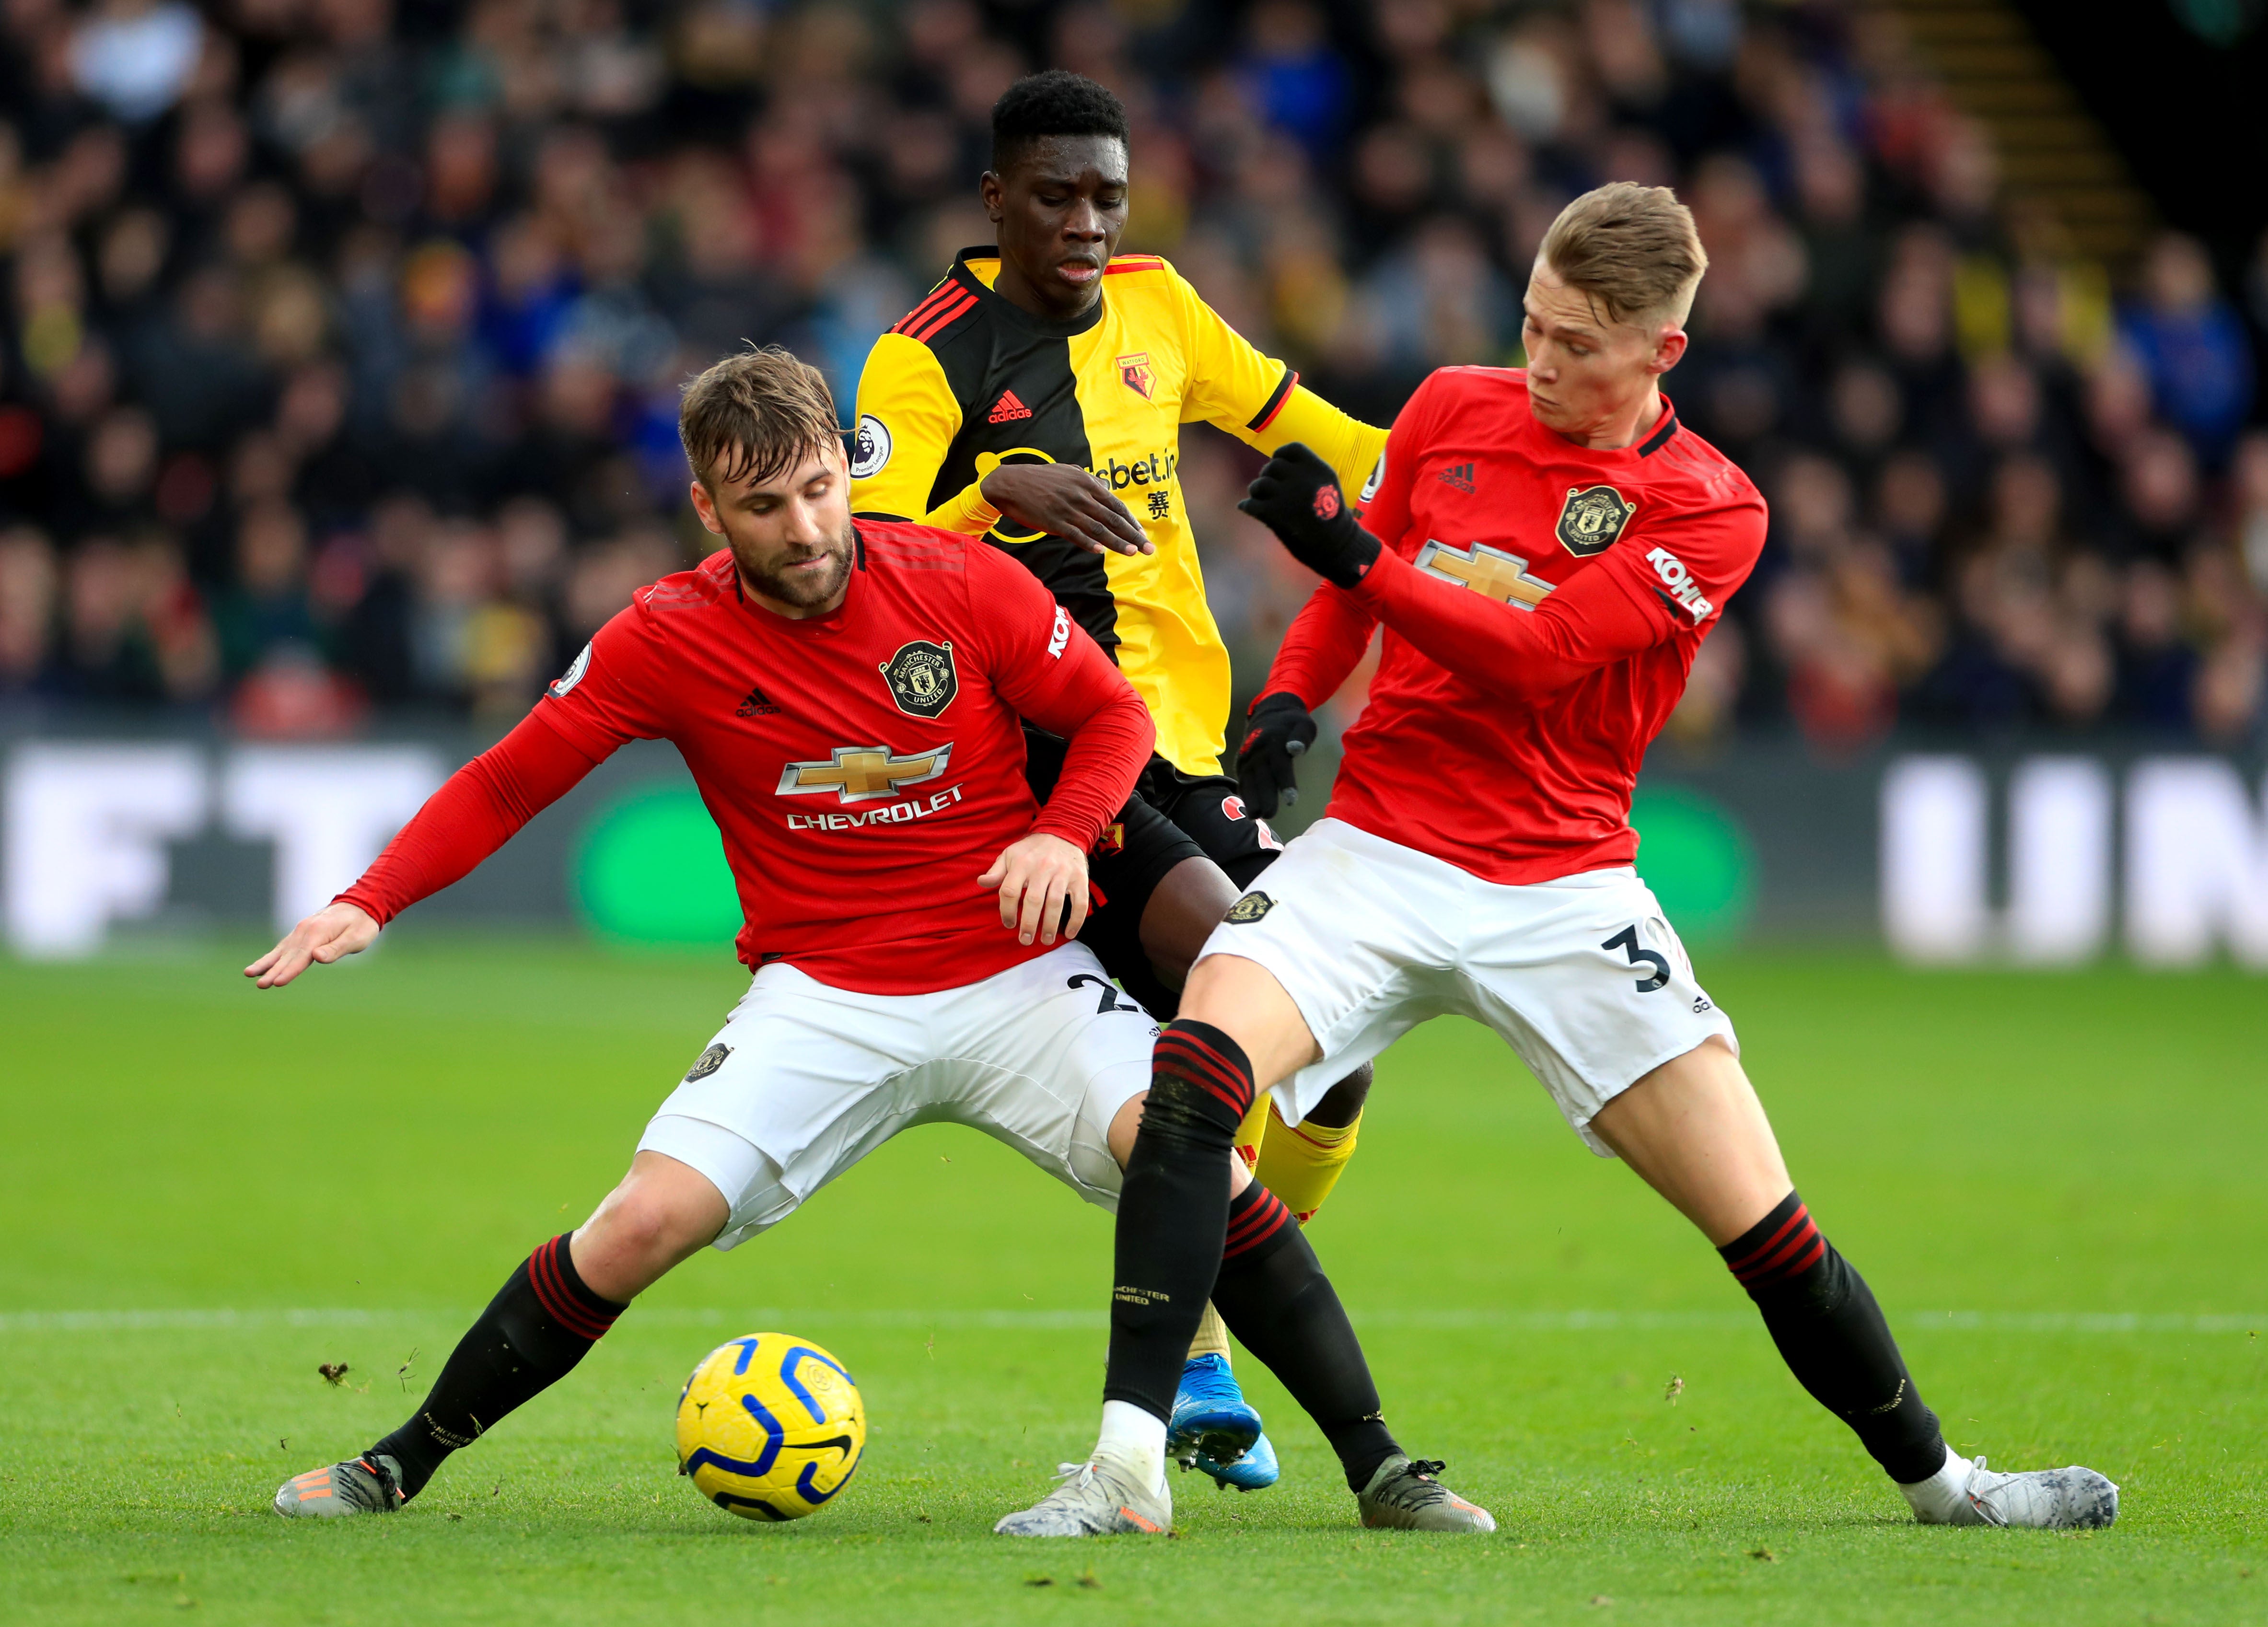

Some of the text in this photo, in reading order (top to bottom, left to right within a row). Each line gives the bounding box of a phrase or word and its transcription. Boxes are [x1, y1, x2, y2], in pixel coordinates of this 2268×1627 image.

[989, 407, 1032, 423] adidas
[856, 445, 884, 473] Premier League
[1438, 472, 1476, 494] adidas
[1148, 490, 1169, 520] 赛
[1570, 528, 1600, 541] UNITED
[898, 654, 941, 679] MANCHESTER
[913, 688, 943, 703] UNITED
[736, 705, 781, 718] adidas
[787, 783, 963, 830] CHEVROLET
[1115, 1293, 1150, 1305] UNITED
